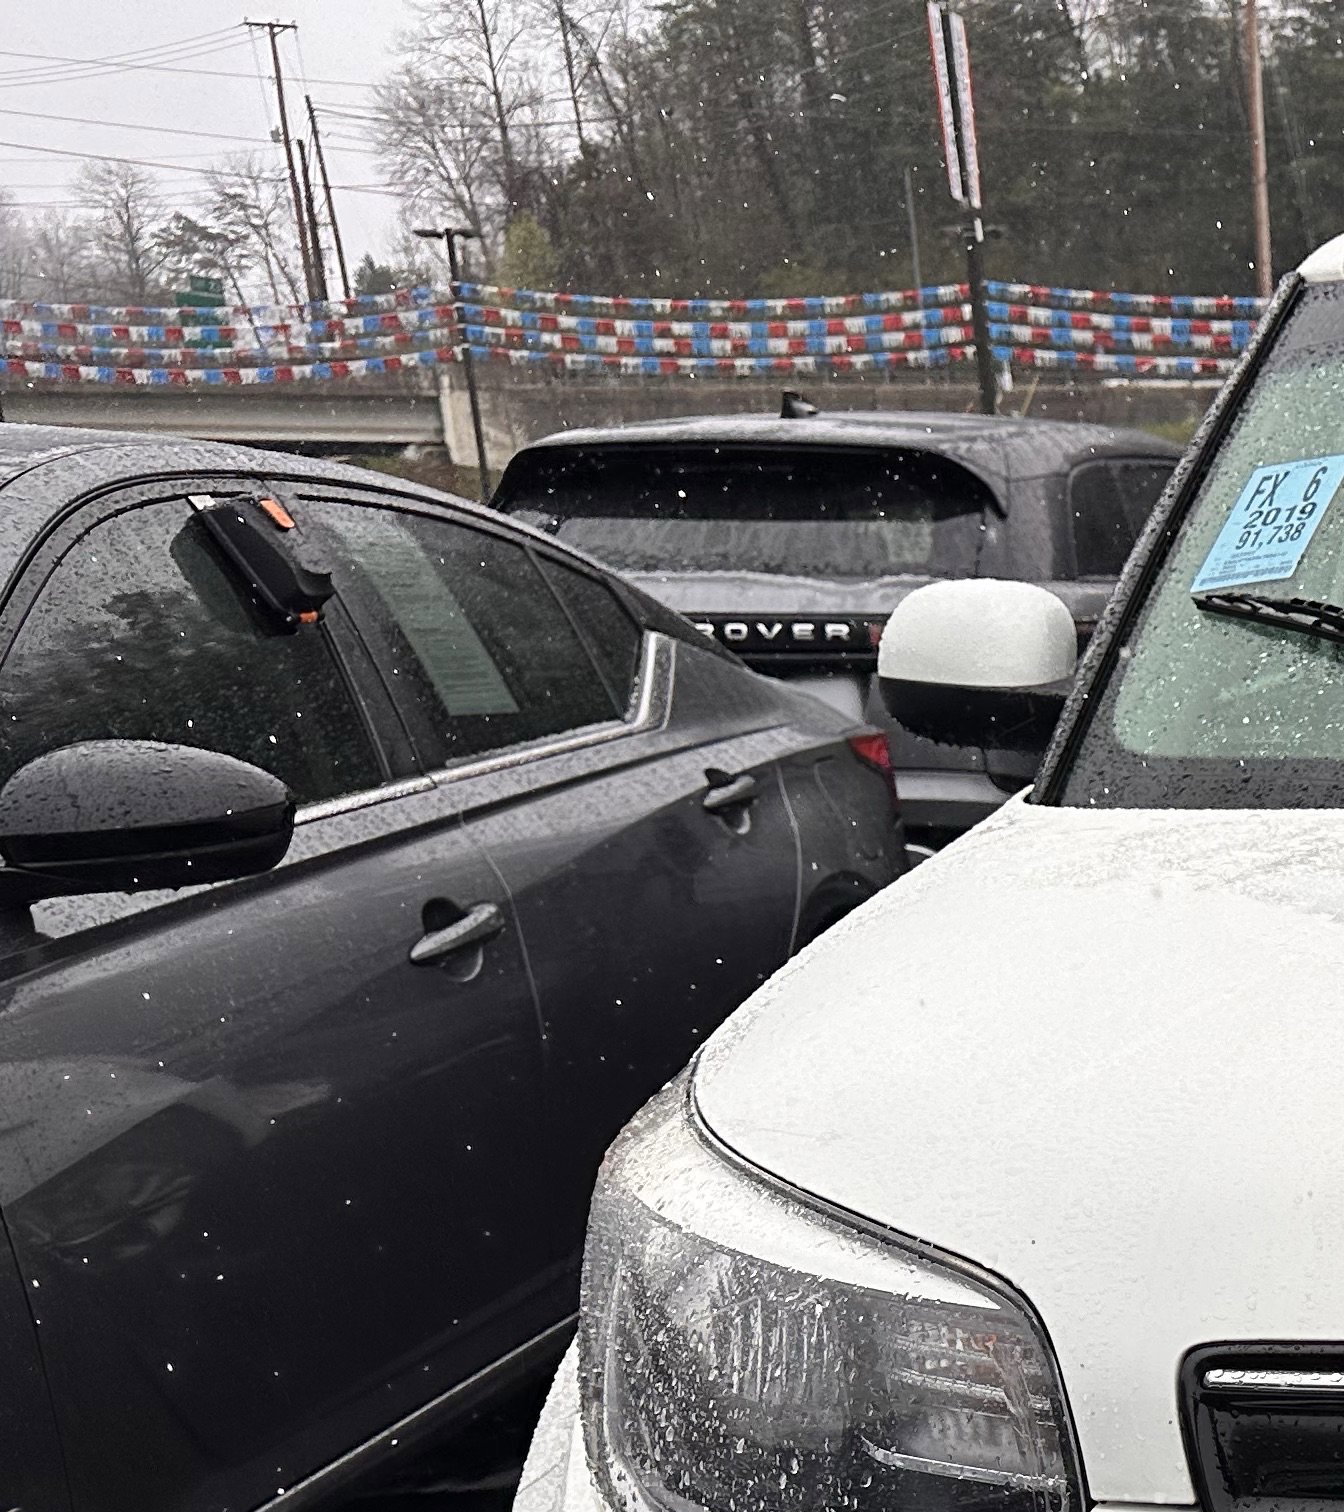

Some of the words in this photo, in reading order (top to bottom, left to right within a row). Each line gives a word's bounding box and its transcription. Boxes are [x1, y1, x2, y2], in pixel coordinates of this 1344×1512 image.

[1244, 471, 1291, 512] FX
[1302, 466, 1328, 502] 6
[1243, 502, 1317, 529] 2019
[1235, 522, 1306, 550] 91,738
